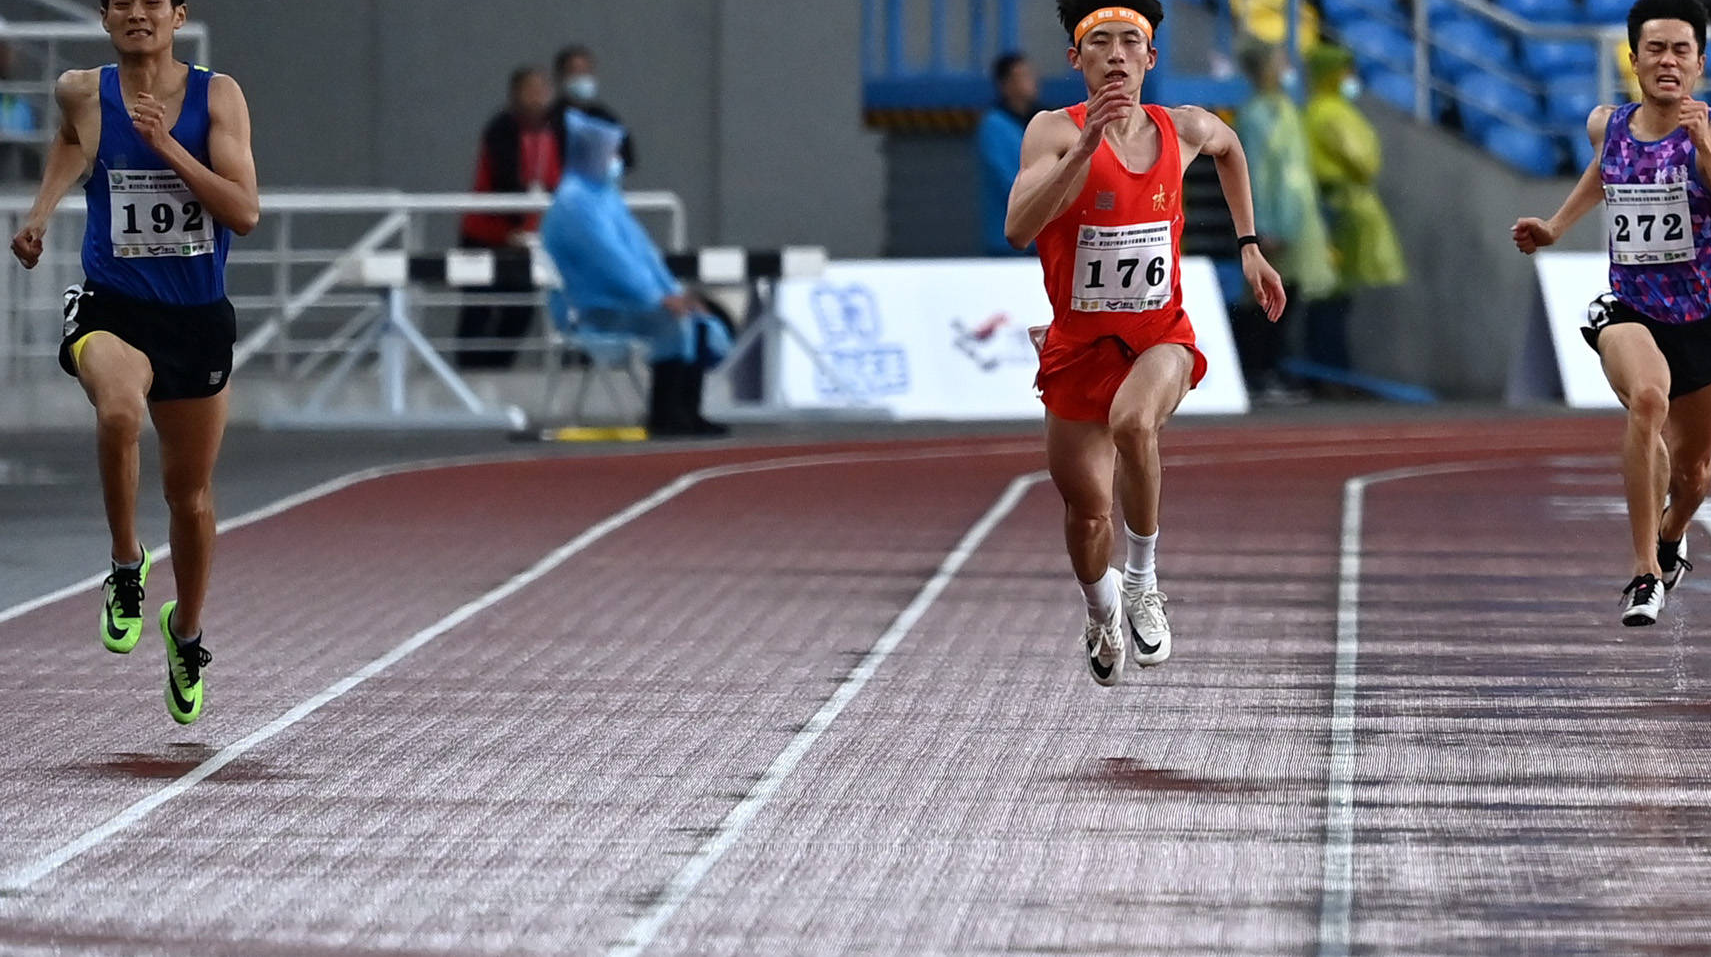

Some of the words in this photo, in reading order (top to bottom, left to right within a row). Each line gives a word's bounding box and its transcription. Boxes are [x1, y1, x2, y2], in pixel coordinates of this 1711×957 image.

[122, 201, 204, 234] 192
[1614, 213, 1684, 242] 272
[1084, 256, 1165, 289] 176
